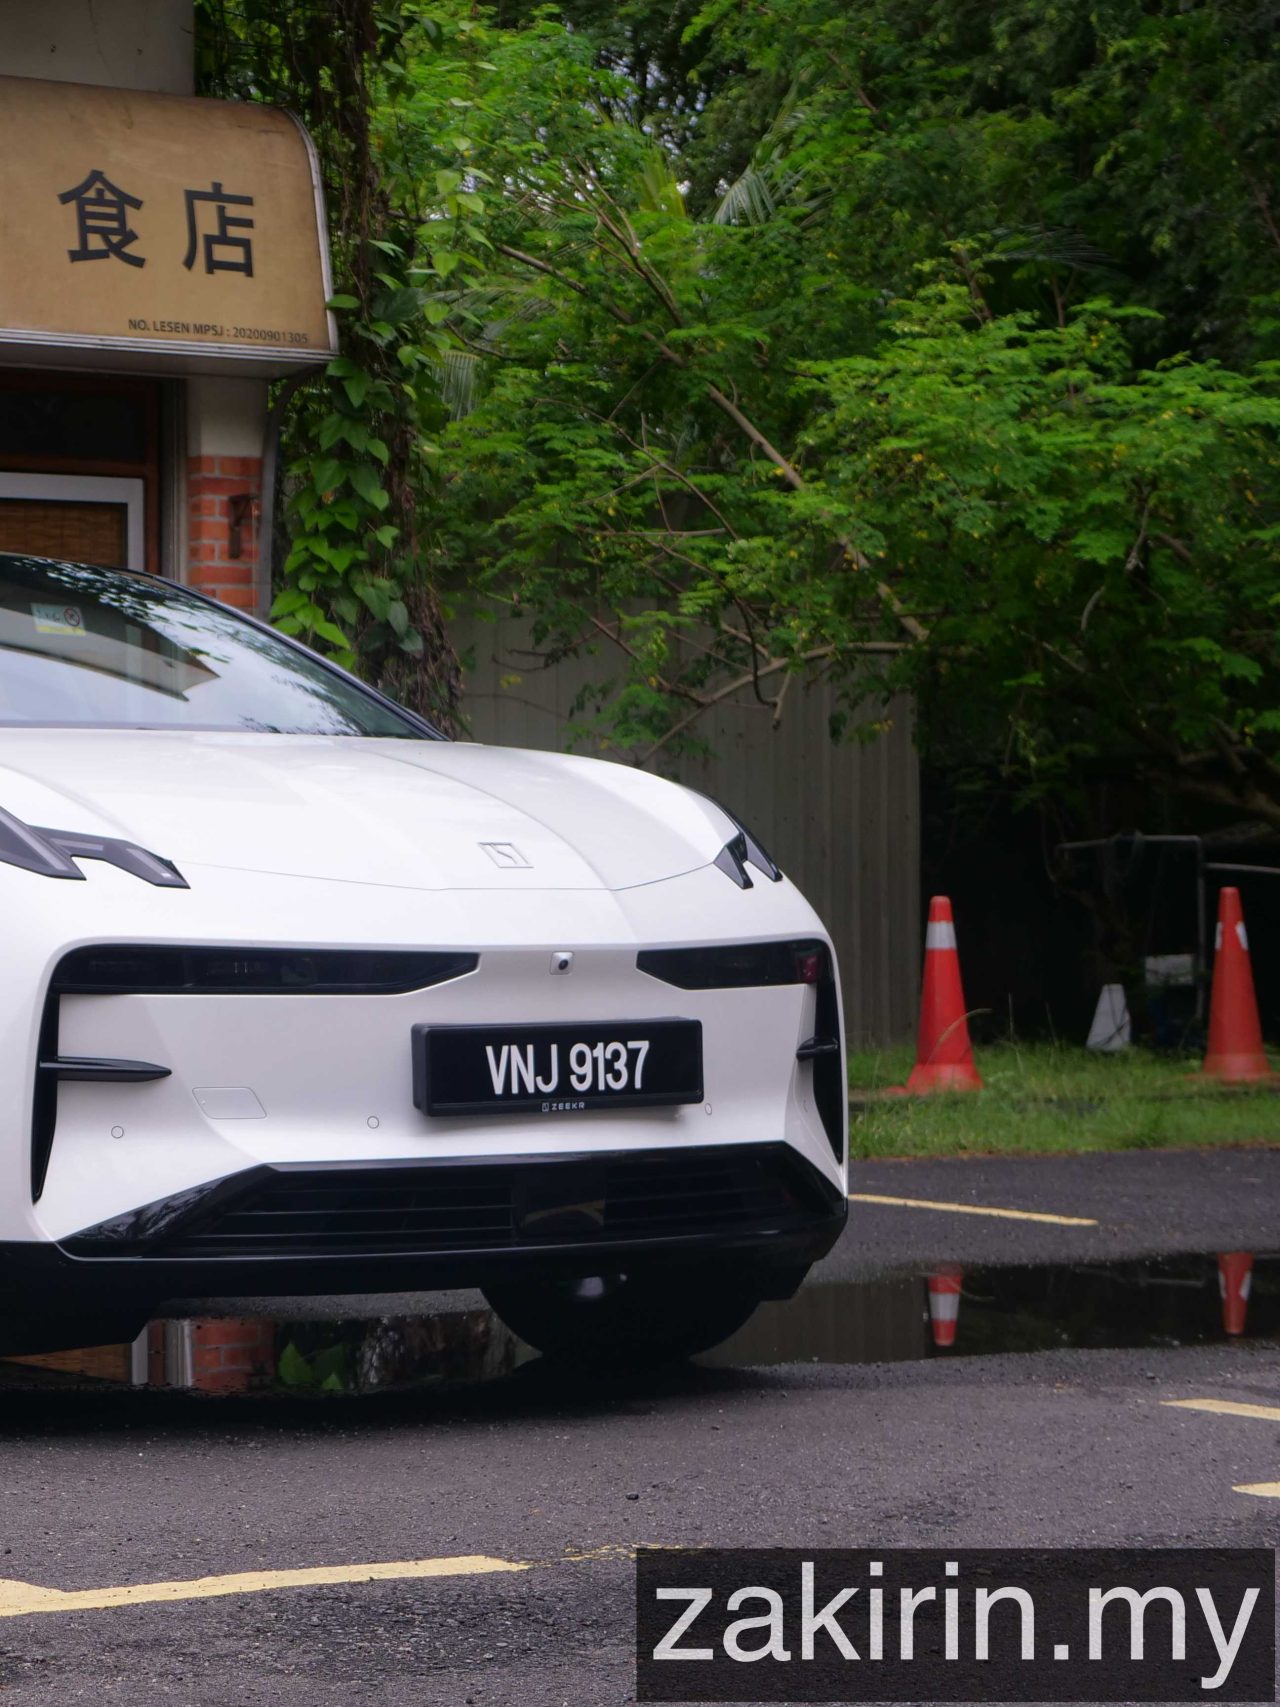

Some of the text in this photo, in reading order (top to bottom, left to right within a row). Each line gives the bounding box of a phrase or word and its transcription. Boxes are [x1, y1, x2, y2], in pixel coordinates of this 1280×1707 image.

[128, 319, 150, 331] NO.
[153, 321, 190, 334] LESEN
[193, 323, 224, 337] MPSJ
[485, 1040, 650, 1095] VNJ 9137
[551, 1102, 585, 1111] ZEEKR
